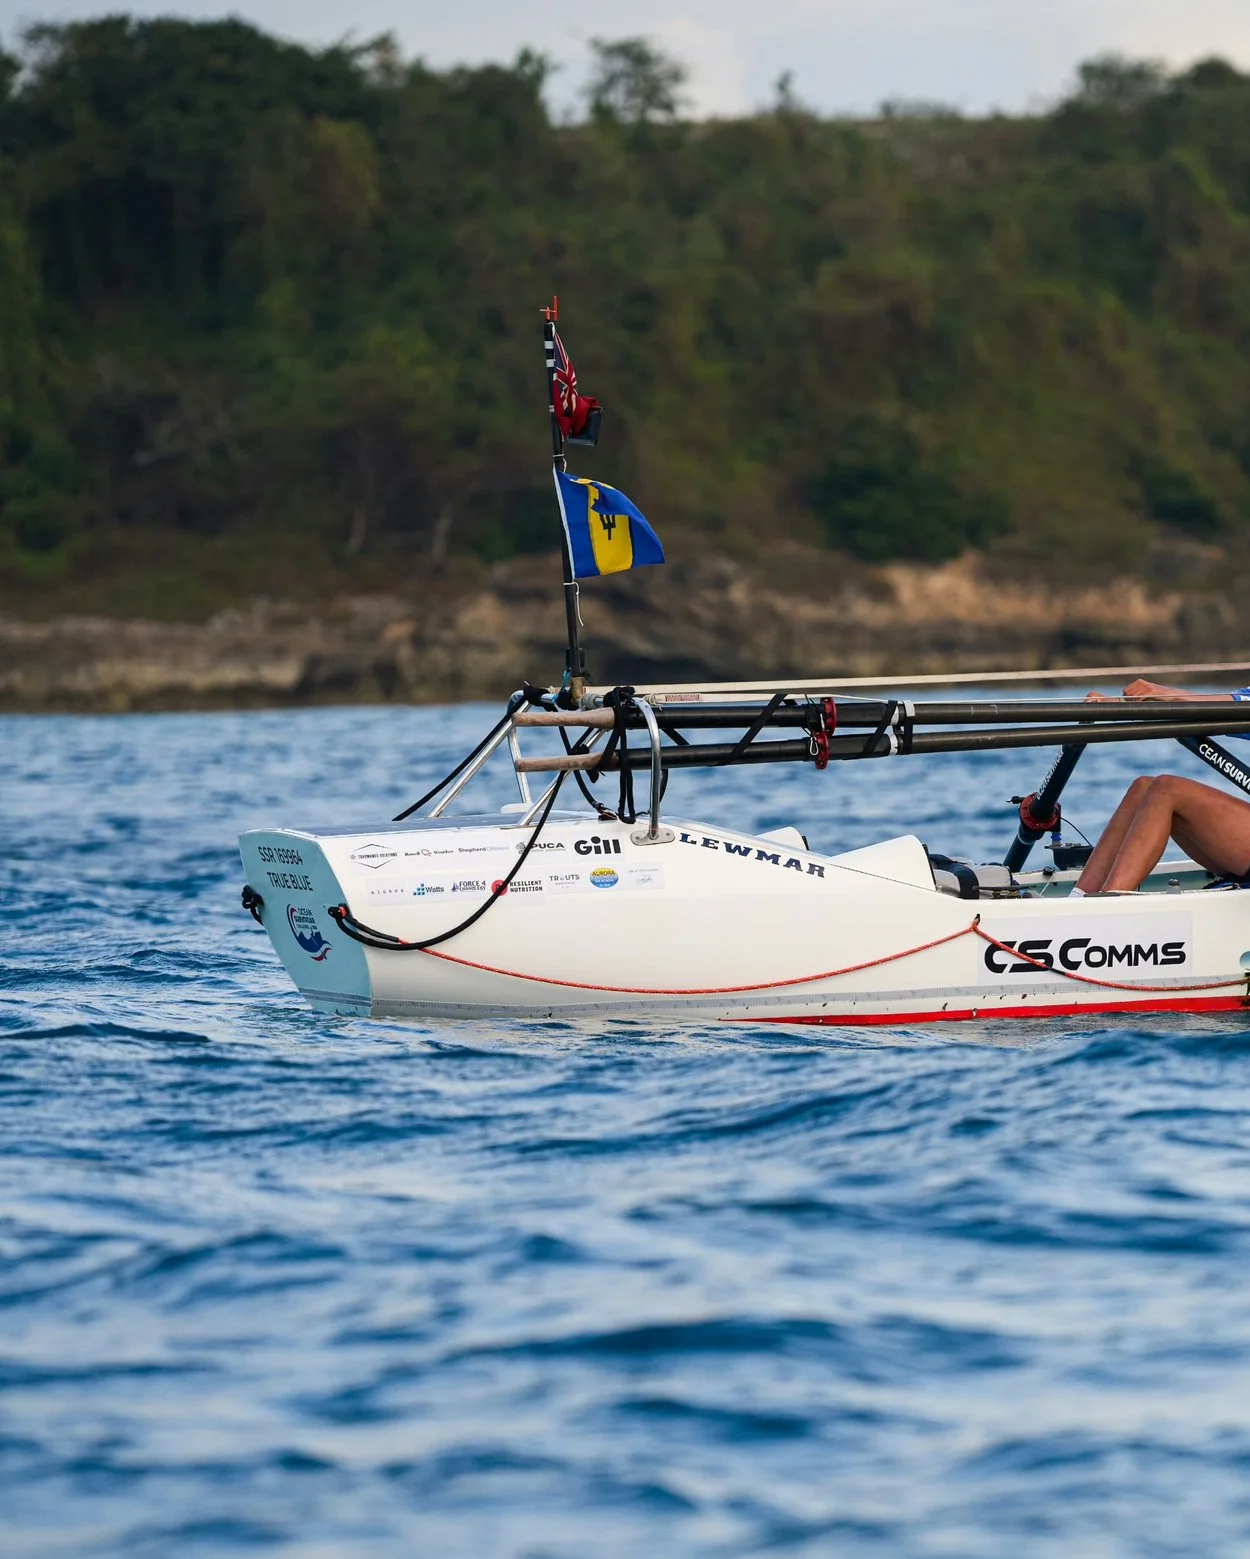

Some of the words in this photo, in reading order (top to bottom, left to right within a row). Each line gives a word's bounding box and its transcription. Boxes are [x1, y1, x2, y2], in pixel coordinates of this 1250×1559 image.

[258, 846, 278, 863] SSR
[574, 836, 622, 856] Gill
[679, 832, 826, 879] LEWMAR
[266, 872, 291, 889] TRUE
[290, 874, 314, 891] BLUE
[459, 880, 480, 888] FORCE
[984, 939, 1054, 974] CS
